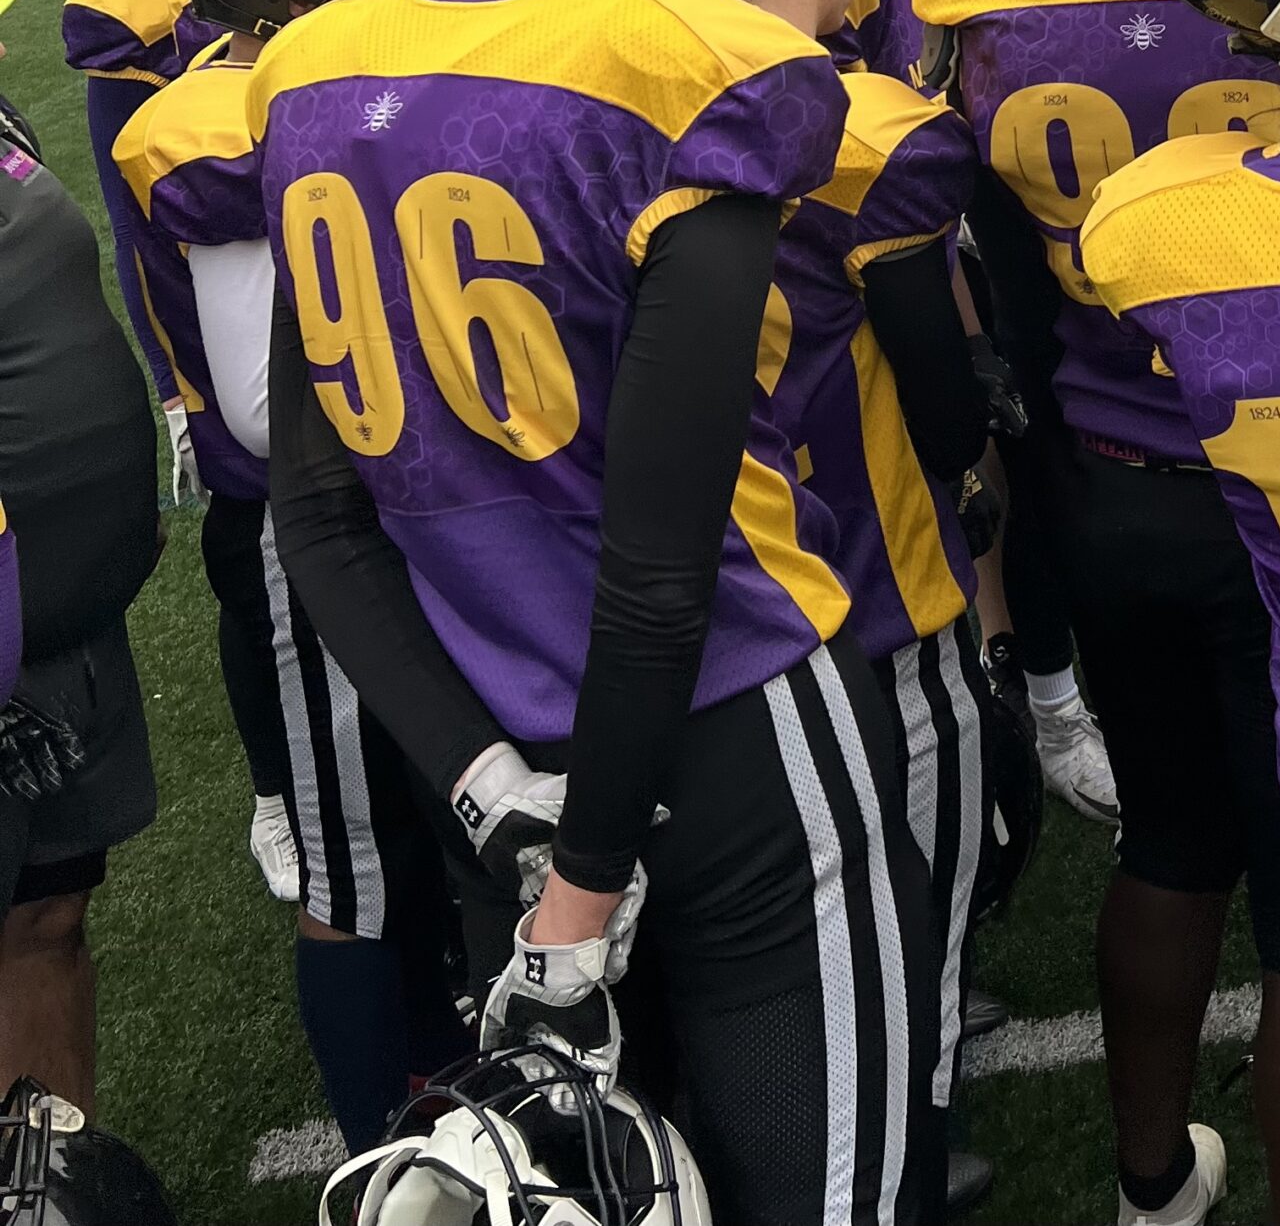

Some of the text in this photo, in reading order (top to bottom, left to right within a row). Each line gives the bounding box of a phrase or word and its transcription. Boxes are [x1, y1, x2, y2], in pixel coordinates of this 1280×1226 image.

[1044, 93, 1069, 106] 1824
[1222, 90, 1250, 104] 1824
[307, 187, 329, 202] 1824
[447, 186, 471, 203] 1824
[283, 171, 581, 462] 96
